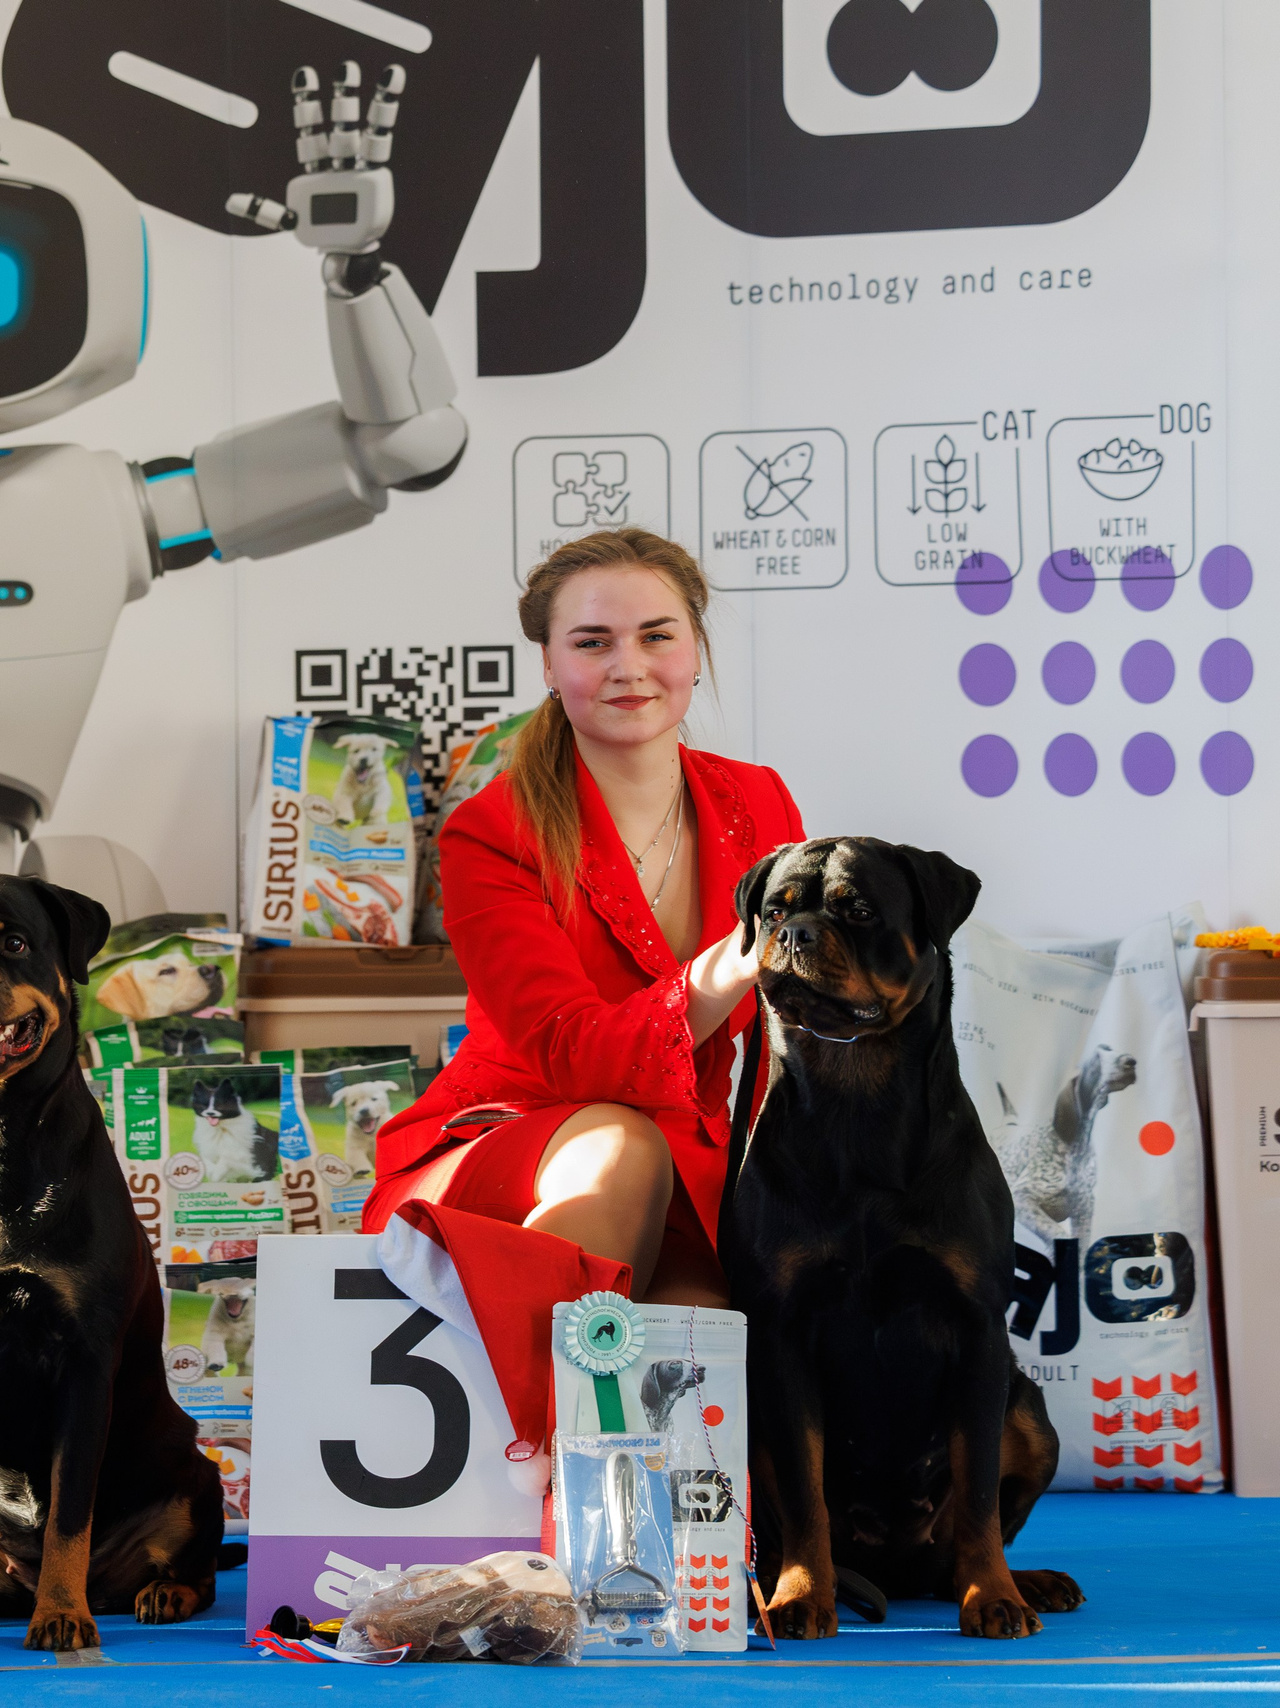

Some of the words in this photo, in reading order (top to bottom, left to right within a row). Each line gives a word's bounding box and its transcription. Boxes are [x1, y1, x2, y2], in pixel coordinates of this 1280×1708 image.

[727, 272, 919, 305] technology
[941, 266, 996, 295] and
[1019, 267, 1093, 291] care
[982, 409, 1037, 441] CAT
[1159, 402, 1212, 434] DOG
[713, 530, 769, 550] WHEAT
[792, 528, 836, 548] CORN
[927, 522, 968, 543] LOW
[1099, 517, 1148, 538] WITH
[755, 556, 801, 575] FREE
[914, 549, 984, 571] GRAIN
[1069, 543, 1177, 567] BUCKWHEAT
[263, 799, 300, 922] SIRIUS
[129, 1131, 156, 1141] ADULT
[1259, 1106, 1267, 1147] PREMIUM
[319, 1268, 472, 1510] 3
